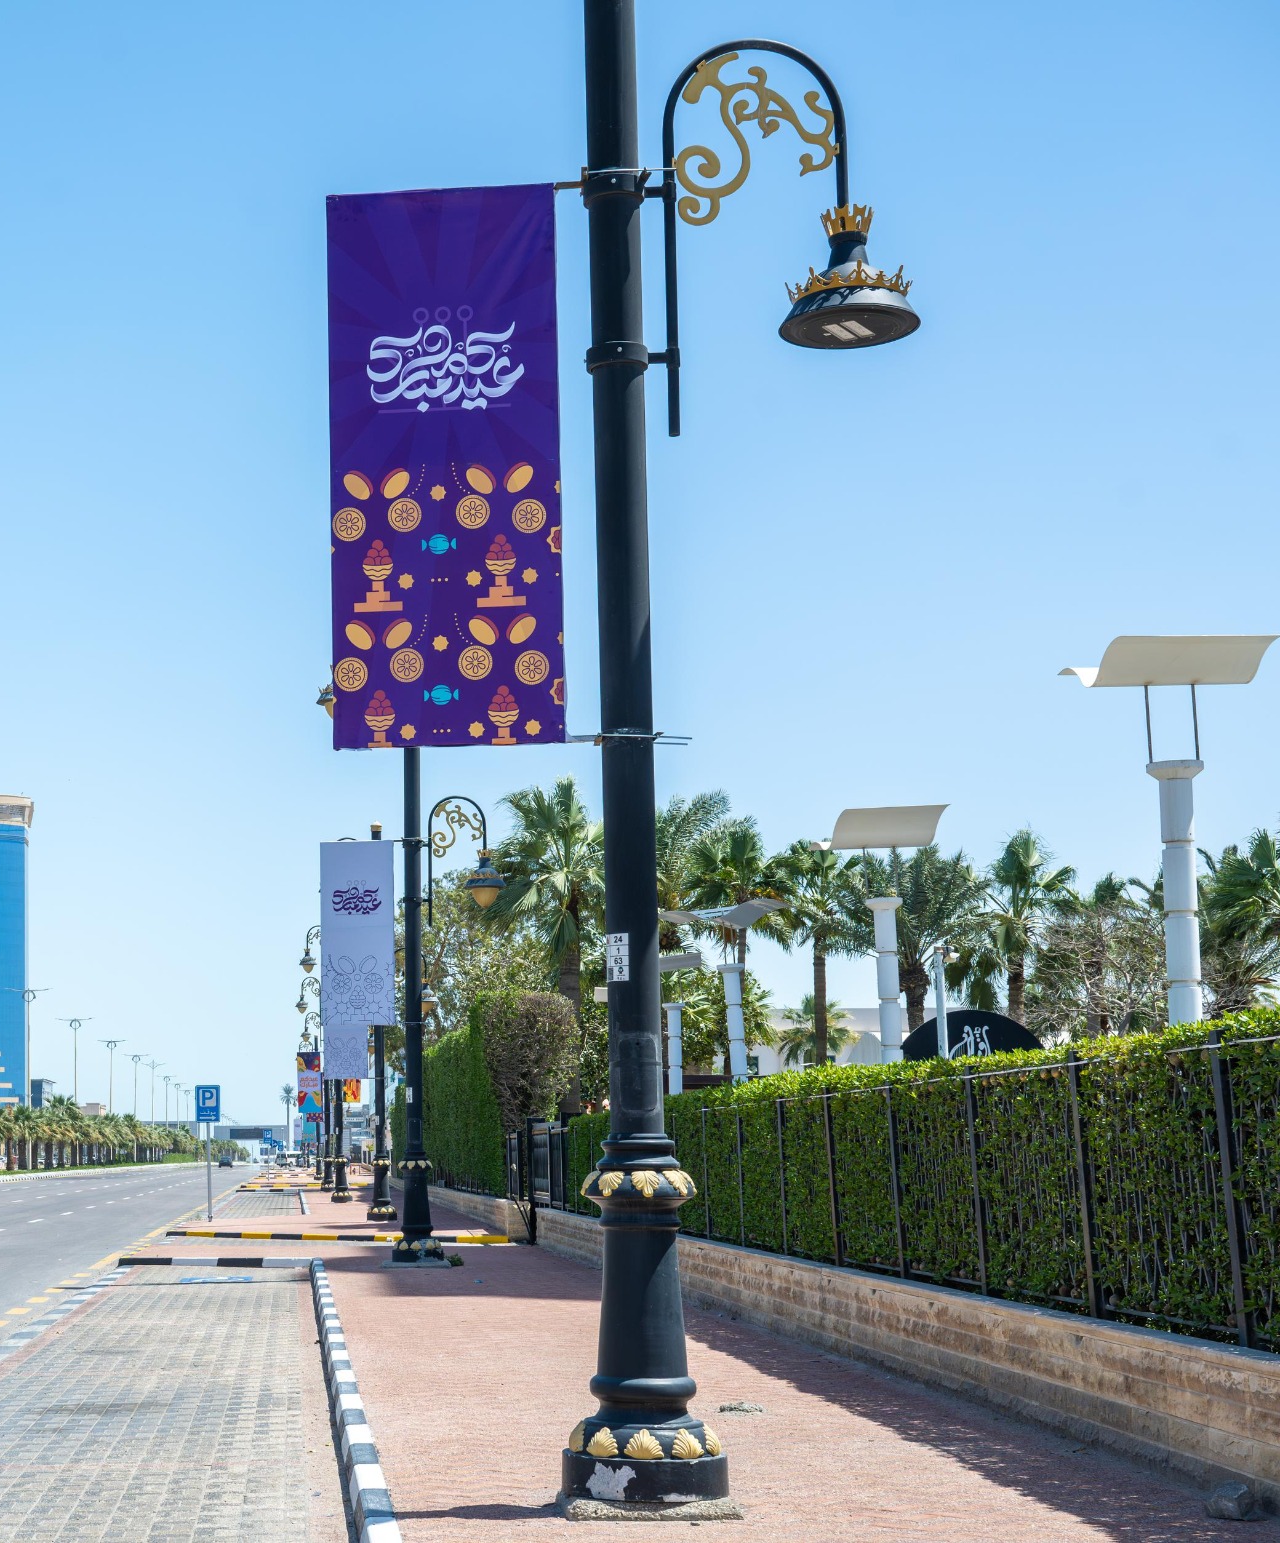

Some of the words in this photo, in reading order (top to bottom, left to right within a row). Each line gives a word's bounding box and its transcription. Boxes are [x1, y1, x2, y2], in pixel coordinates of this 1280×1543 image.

[613, 935, 623, 944] 24
[616, 947, 620, 955] 1
[613, 957, 623, 965] 63
[201, 1089, 214, 1106] P
